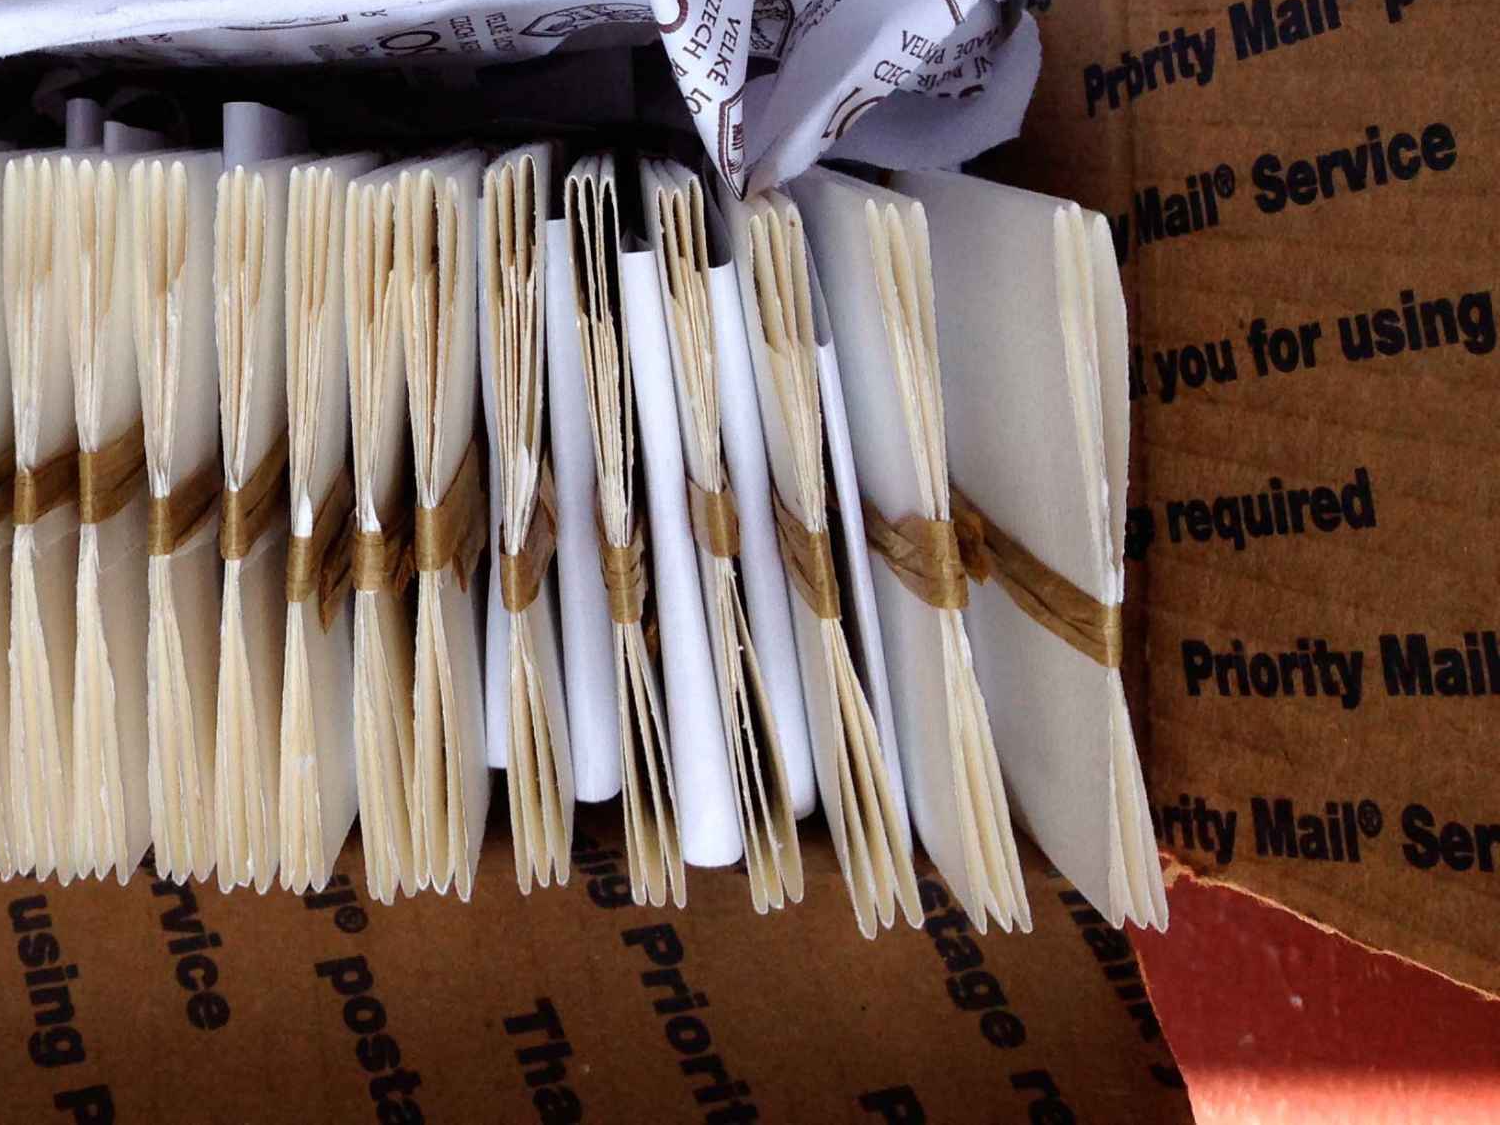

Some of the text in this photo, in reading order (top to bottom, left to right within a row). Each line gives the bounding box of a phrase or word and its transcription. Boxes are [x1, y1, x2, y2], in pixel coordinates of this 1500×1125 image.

[705, 17, 741, 87] VELKÉ
[1136, 164, 1236, 245] Mail®
[1251, 123, 1457, 213] Service
[1154, 338, 1238, 403] you
[1247, 318, 1322, 377] for
[1338, 289, 1497, 355] using
[1166, 466, 1377, 551] required
[1180, 638, 1364, 710] Priority
[1250, 795, 1383, 863] Mail®
[8, 893, 86, 1068] using
[151, 874, 231, 1031] rvice
[621, 923, 759, 1125] Priorit
